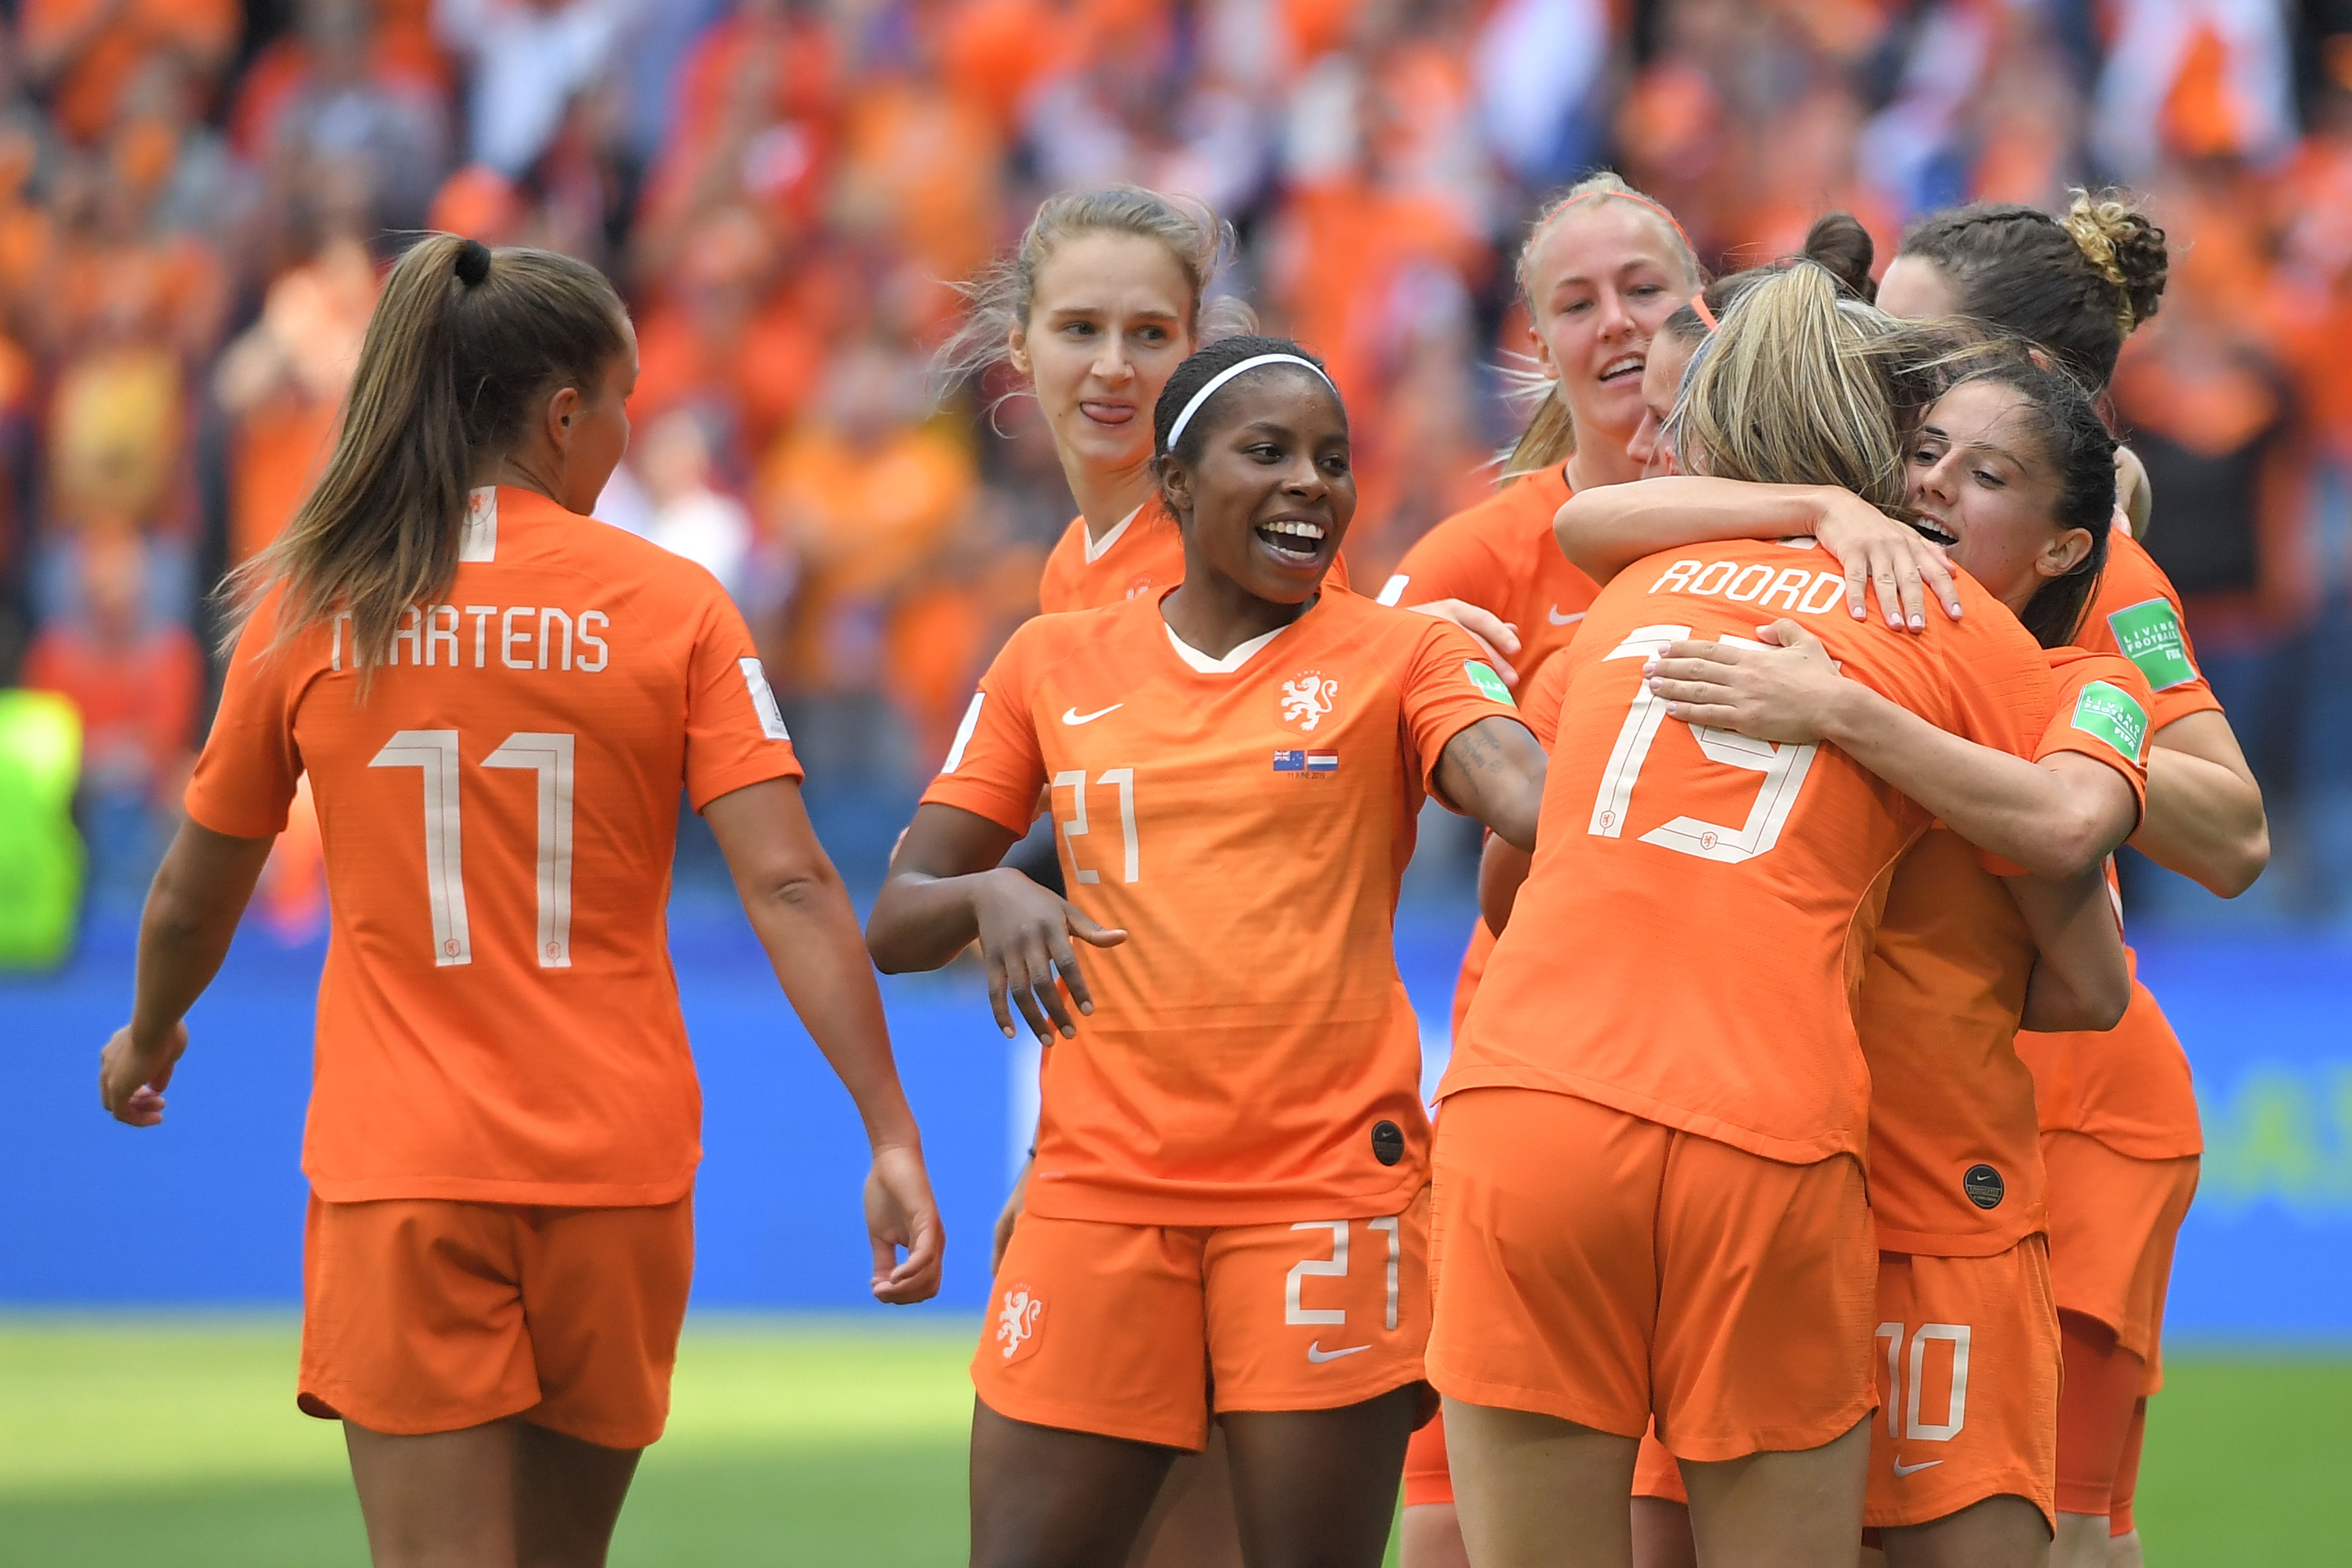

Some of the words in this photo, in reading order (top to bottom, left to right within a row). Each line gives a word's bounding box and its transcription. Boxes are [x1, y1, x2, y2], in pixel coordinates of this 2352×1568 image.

[1648, 560, 1846, 614] ROORD
[2123, 621, 2175, 643] LIVING
[2127, 631, 2178, 653] FOOTBALL
[2084, 702, 2138, 739] FOOTBALL
[2086, 696, 2140, 733] LIVING
[2114, 726, 2136, 751] FIFA
[1587, 624, 1841, 864] 19
[368, 730, 575, 968] 11
[1053, 768, 1139, 884] 21
[1286, 1216, 1400, 1330] 21
[1876, 1322, 1971, 1441] 10
